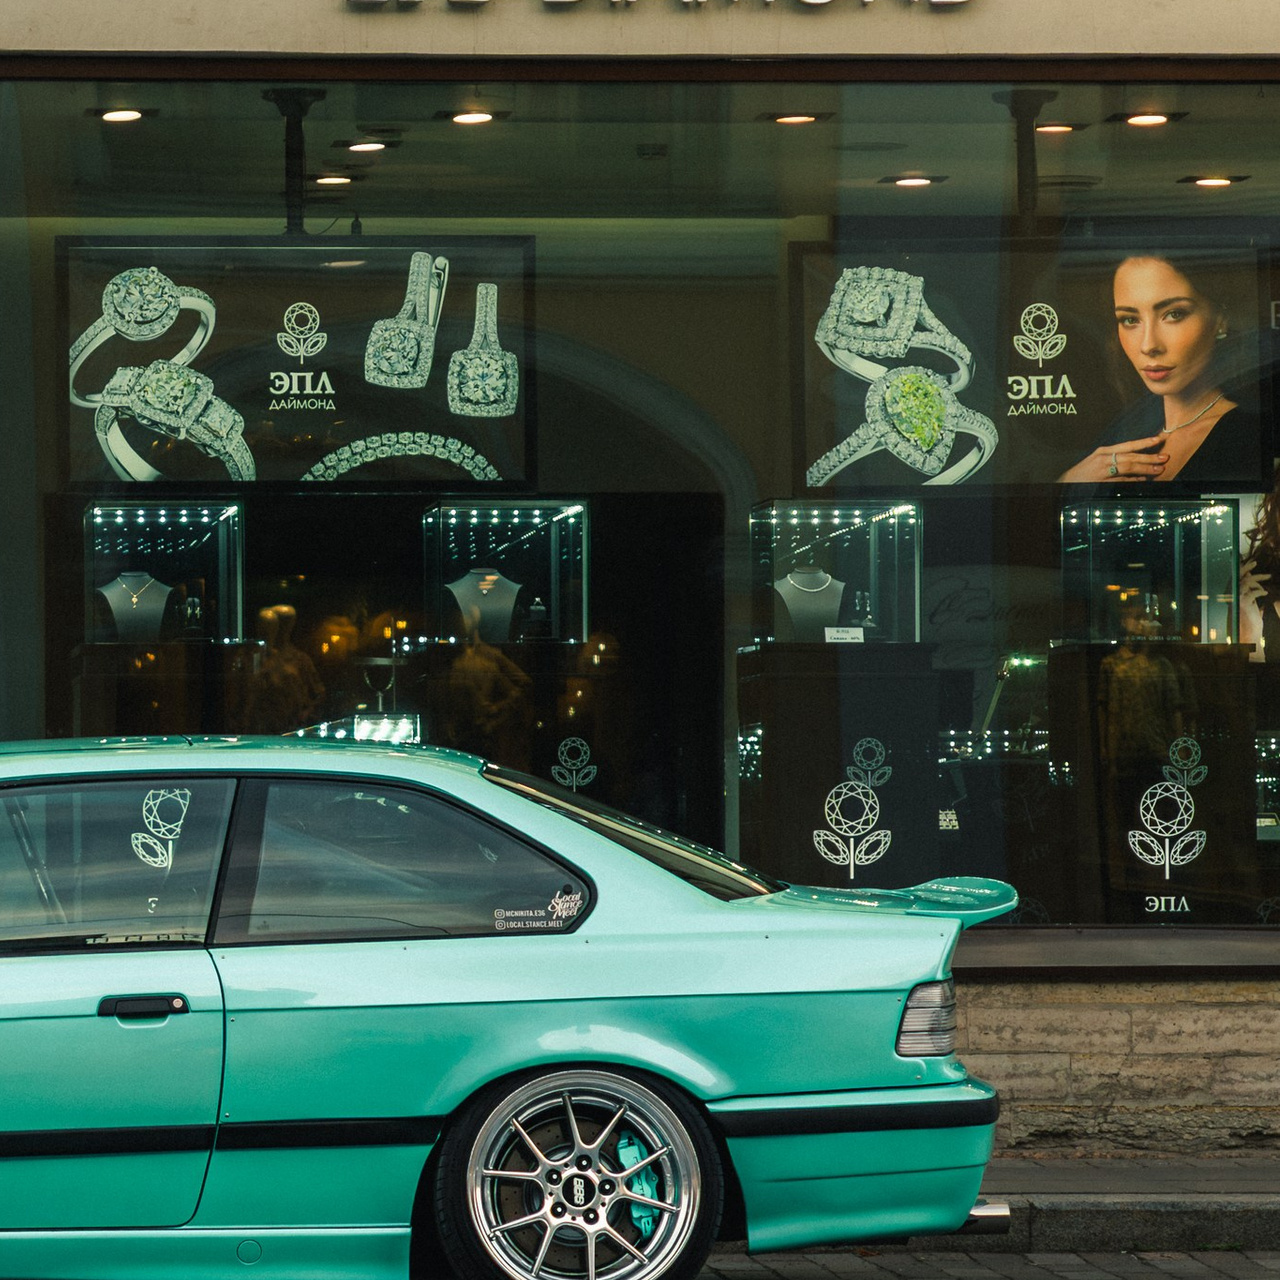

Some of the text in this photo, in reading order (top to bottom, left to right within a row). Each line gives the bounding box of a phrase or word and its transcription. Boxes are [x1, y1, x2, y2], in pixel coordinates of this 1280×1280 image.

[269, 371, 336, 395] ЭПЛ
[1007, 374, 1077, 400] ЭПЛ
[269, 396, 336, 410] ДАЙМОНД
[1007, 402, 1077, 416] ДАЙМОНД
[548, 898, 583, 912] Stance
[1145, 896, 1191, 912] ЭПЛ
[553, 907, 578, 919] Meet
[506, 920, 563, 928] LOCAL.STANCE.MEET
[573, 1177, 585, 1206] BBS
